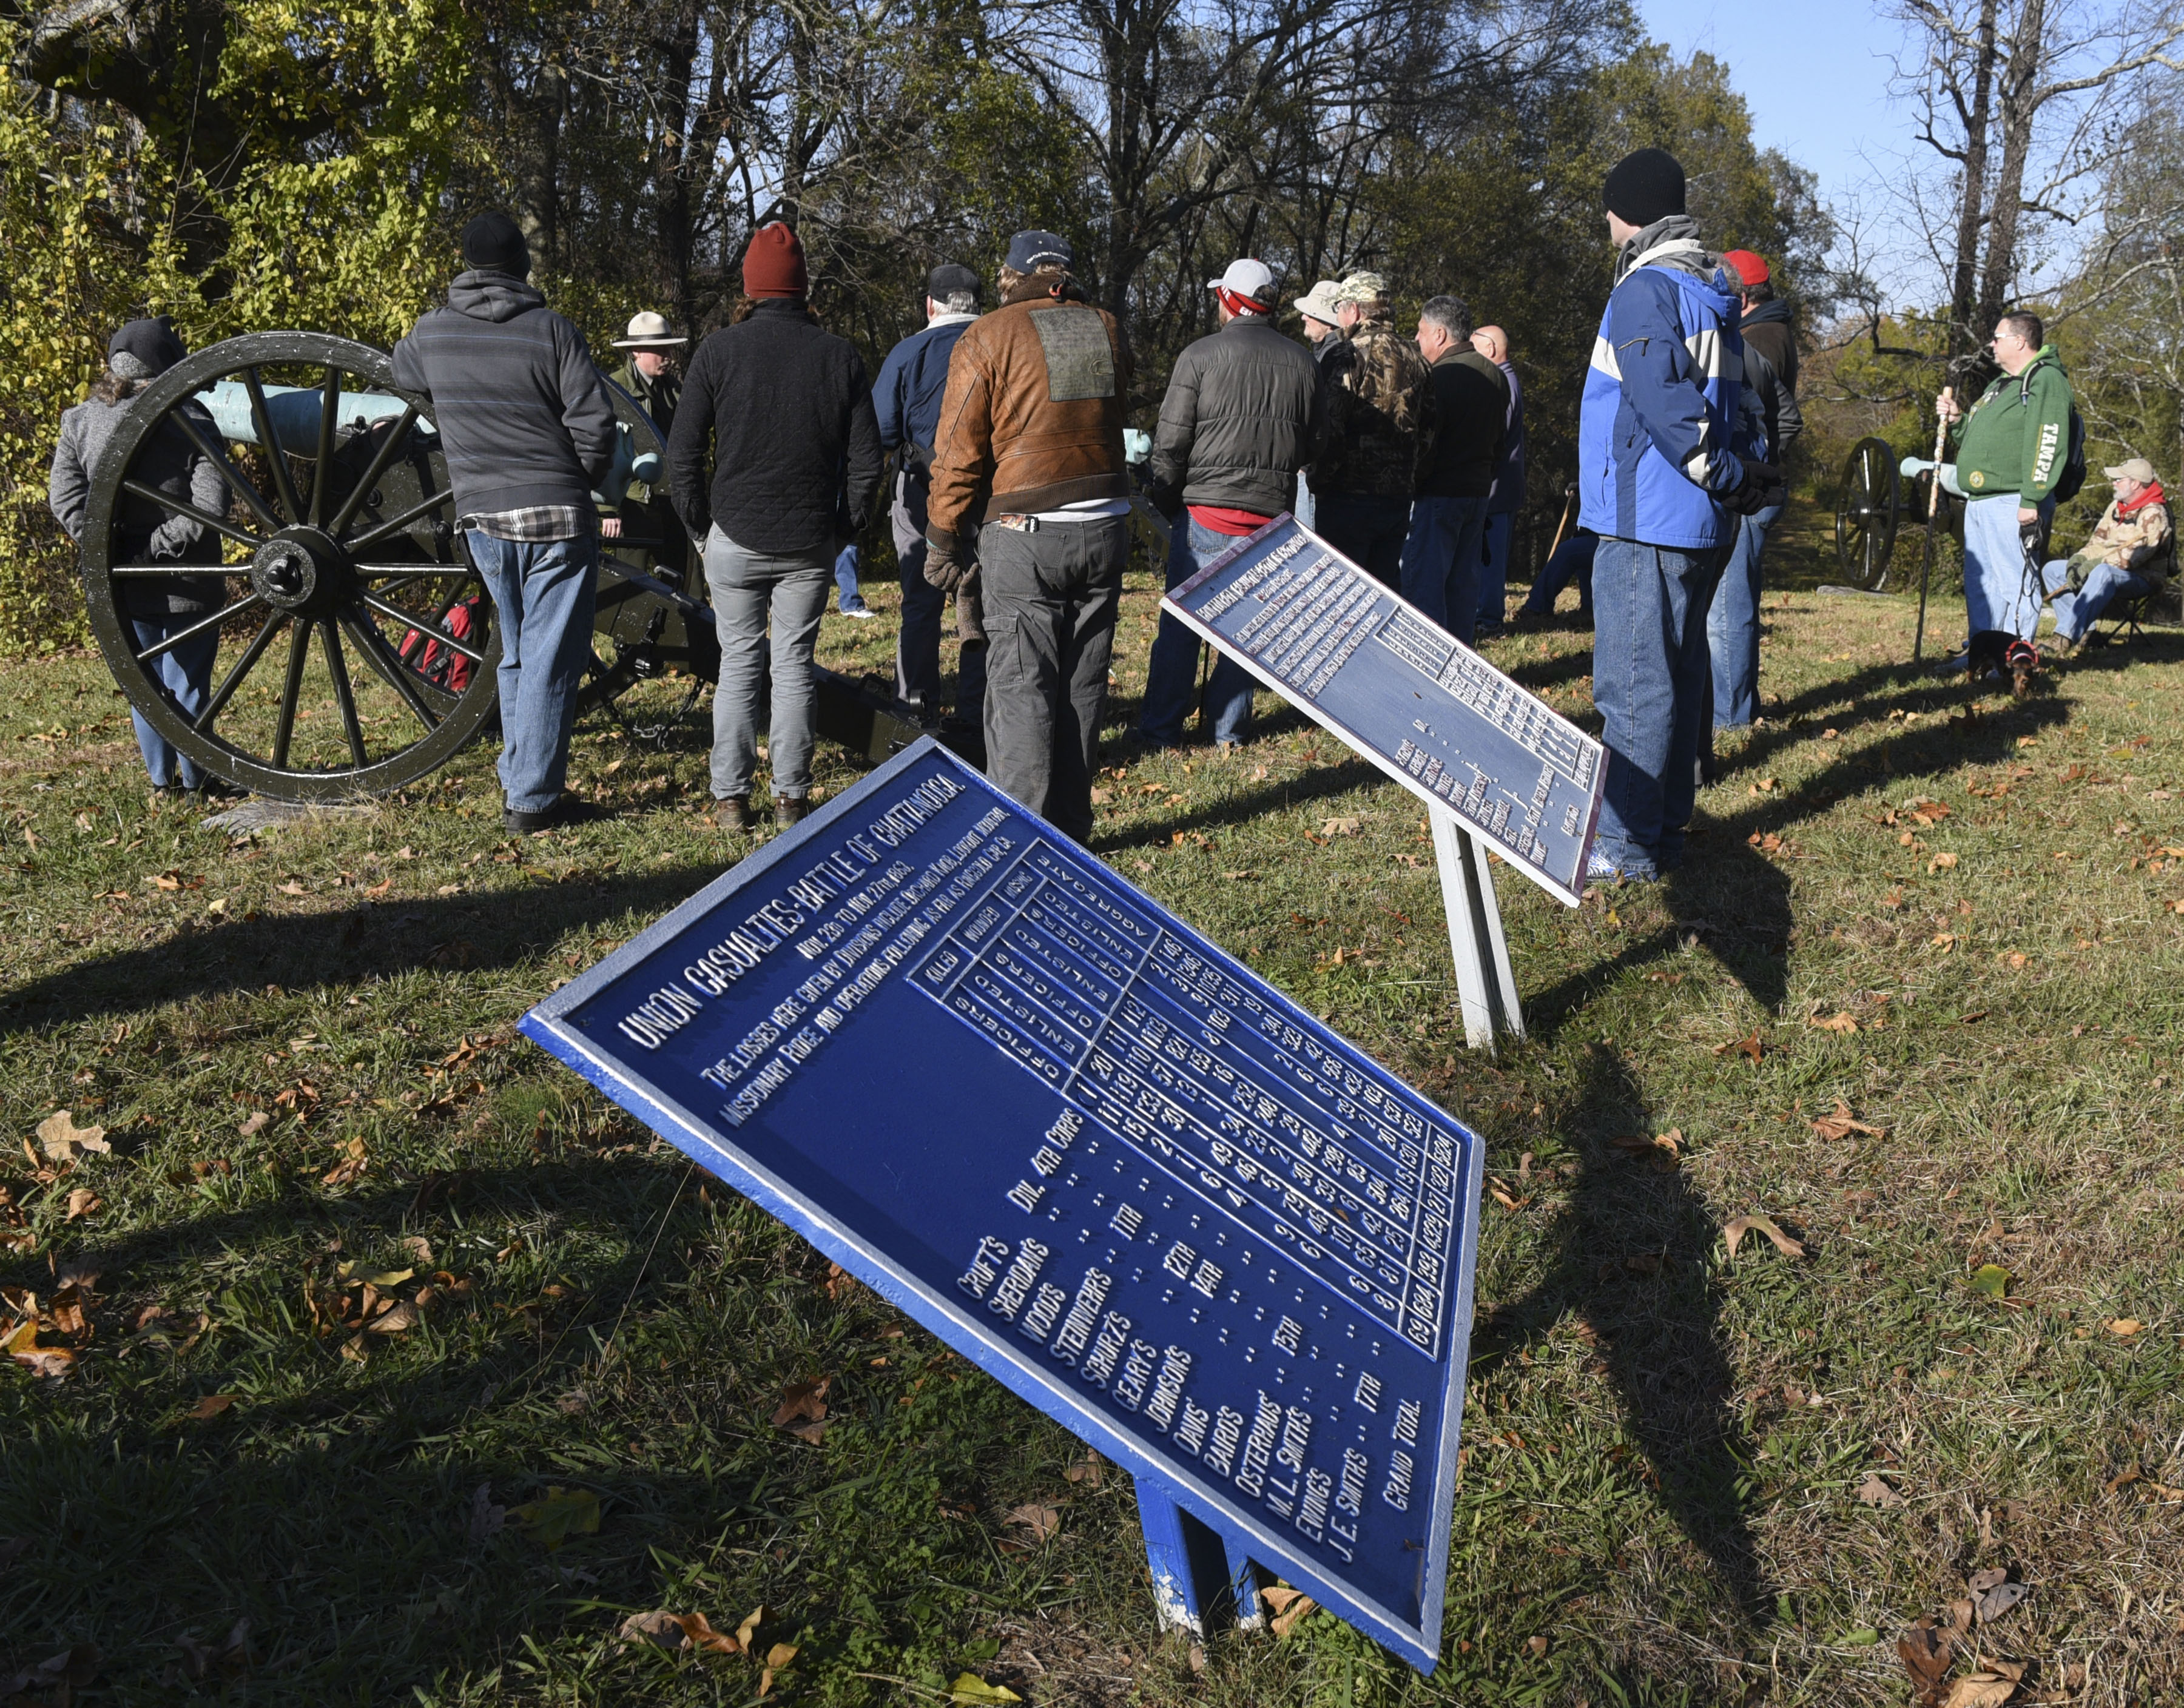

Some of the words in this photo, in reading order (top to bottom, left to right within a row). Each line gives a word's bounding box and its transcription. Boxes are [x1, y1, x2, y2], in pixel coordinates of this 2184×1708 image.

[2032, 423, 2059, 482] TAMPA
[900, 870, 941, 905] ORCHARD
[947, 884, 965, 899] AS
[1037, 855, 1147, 936] AGGREGATE
[617, 981, 703, 1049] UNION
[845, 833, 881, 862] OF
[868, 772, 966, 846] CHATTANOOGA.
[872, 896, 911, 930] INCLUDE
[922, 906, 942, 924] AS
[931, 893, 956, 914] FAR
[794, 935, 829, 960] NOV.
[817, 921, 844, 943] 23D
[834, 907, 857, 926] TO
[846, 892, 877, 915] NOV.
[925, 950, 959, 984] KILLED
[963, 906, 1000, 943] WOUNDED
[1004, 870, 1033, 896] MISSING
[1044, 892, 1133, 960] ENLISTED
[832, 923, 882, 968] DIVISIONS
[880, 916, 931, 966] FOLLOWING
[1031, 907, 1121, 978] OFFICERS
[1158, 938, 1182, 963] 146
[821, 958, 846, 979] BY
[1015, 929, 1108, 1002] ENLISTED
[1149, 961, 1169, 978] 2
[1176, 952, 1202, 981] 1346
[795, 972, 834, 1003] GIVEN
[833, 957, 891, 1011] OPERATIONS
[995, 952, 1093, 1028] OFFICERS
[1170, 976, 1189, 992] 3
[1196, 966, 1222, 996] 1035
[1219, 983, 1242, 1006] 311
[769, 995, 807, 1029] HERE
[1190, 991, 1209, 1007] 9
[813, 1006, 843, 1034] AND
[974, 975, 1075, 1055] ENLISTED
[1120, 1000, 1146, 1028] 112
[1206, 1007, 1231, 1032] 103
[1260, 1012, 1282, 1037] 341
[728, 1021, 780, 1069] LOSSES
[777, 1026, 824, 1064] RIDGE
[954, 996, 1059, 1079] OFFICERS
[1105, 1029, 1127, 1052] 11
[1139, 1016, 1168, 1049] 1103
[1164, 1032, 1190, 1060] 821
[1201, 1029, 1221, 1046] 8
[1281, 1026, 1303, 1051] 323
[1124, 1045, 1151, 1074] 110
[1187, 1047, 1212, 1076] 155
[1273, 1052, 1293, 1069] 2
[1304, 1040, 1323, 1060] 42
[699, 1057, 743, 1089] THE
[1090, 1054, 1114, 1081] 20
[1150, 1061, 1174, 1087] 57
[1295, 1067, 1315, 1083] 6
[1321, 1054, 1343, 1080] 566
[719, 1057, 792, 1126] MISSIONARY
[1108, 1072, 1138, 1103] 119
[1174, 1079, 1198, 1102] 13
[1315, 1081, 1334, 1097] 6
[1343, 1069, 1363, 1095] 432
[1362, 1083, 1383, 1109] 103
[1133, 1089, 1162, 1121] 133
[1232, 1081, 1257, 1112] 252
[1336, 1097, 1356, 1119] 39
[1097, 1100, 1123, 1125] 11
[1159, 1106, 1185, 1131] 30
[1219, 1112, 1245, 1137] 34
[1253, 1095, 1278, 1128] 248
[1278, 1112, 1301, 1137] 29
[1358, 1113, 1377, 1130] 2
[1382, 1097, 1402, 1125] 637
[1044, 1107, 1084, 1149] CORPS
[1121, 1116, 1148, 1142] 15
[1331, 1123, 1350, 1139] 4
[1377, 1127, 1397, 1151] 20
[1403, 1112, 1423, 1139] 523
[1150, 1135, 1173, 1157] 2
[1209, 1140, 1233, 1166] 49
[1244, 1128, 1267, 1154] 23
[1269, 1145, 1290, 1164] 2
[1300, 1127, 1323, 1158] 442
[1432, 1133, 1453, 1167] 5824
[1030, 1145, 1062, 1176] 4TH
[1233, 1157, 1258, 1182] 46
[1321, 1143, 1345, 1175] 298
[1398, 1142, 1418, 1169] 130
[1199, 1170, 1222, 1189] 6
[1259, 1173, 1281, 1191] 5
[1291, 1161, 1313, 1186] 30
[1346, 1158, 1367, 1183] 85
[1394, 1168, 1415, 1191] 15
[1429, 1164, 1449, 1192] 322
[1006, 1178, 1046, 1214] DIV.,
[1080, 1310, 1131, 1388] SCHURZ'S
[1212, 1063, 1235, 1086] 16
[1242, 996, 1262, 1015] 19
[1225, 1188, 1247, 1208] 4
[1313, 1177, 1336, 1203] 39
[1339, 1194, 1359, 1211] 6
[1365, 1174, 1389, 1205] 504
[1426, 1190, 1446, 1215] 27
[1281, 1191, 1305, 1218] 79
[1388, 1189, 1411, 1222] 264
[1108, 1202, 1143, 1241] 11TH
[1273, 1223, 1296, 1241] 9
[1306, 1208, 1329, 1234] 46
[1361, 1211, 1382, 1235] 42
[1422, 1212, 1444, 1249] 4329
[1299, 1240, 1321, 1259] 6
[1330, 1225, 1352, 1250] 10
[1383, 1225, 1404, 1252] 25
[956, 1235, 1009, 1299] CRUFT'S
[1162, 1240, 1196, 1280] 12TH
[1353, 1241, 1377, 1268] 65
[1417, 1250, 1439, 1284] 393
[987, 1237, 1049, 1322] SHERIDAN'S
[1189, 1258, 1224, 1299] 14TH
[1348, 1274, 1370, 1293] 6
[1378, 1259, 1400, 1285] 81
[1018, 1281, 1067, 1343] WOOD'S
[1372, 1292, 1395, 1311] 8
[1412, 1283, 1435, 1319] 684
[1050, 1266, 1112, 1366] STEINWEHR'S
[1271, 1314, 1303, 1357] 15TH
[1407, 1317, 1431, 1345] 69
[1111, 1337, 1158, 1411] GEARY'S
[1142, 1344, 1192, 1433] JOHNSON'S
[1353, 1370, 1381, 1413] 17TH
[1172, 1396, 1210, 1456] DAVIS'
[1391, 1398, 1421, 1447] TOTAL.
[1202, 1404, 1244, 1478] BAIRD'S
[1234, 1388, 1282, 1498] OSTERHAUS'
[1275, 1405, 1312, 1473] SMITH'S
[1269, 1476, 1299, 1497] L.
[1335, 1447, 1367, 1516] SMITH'S
[1382, 1450, 1413, 1510] GRAND
[1266, 1491, 1294, 1519] M.
[1295, 1466, 1332, 1542] EWING'S
[1329, 1515, 1358, 1542] E.
[1327, 1538, 1353, 1562] J.
